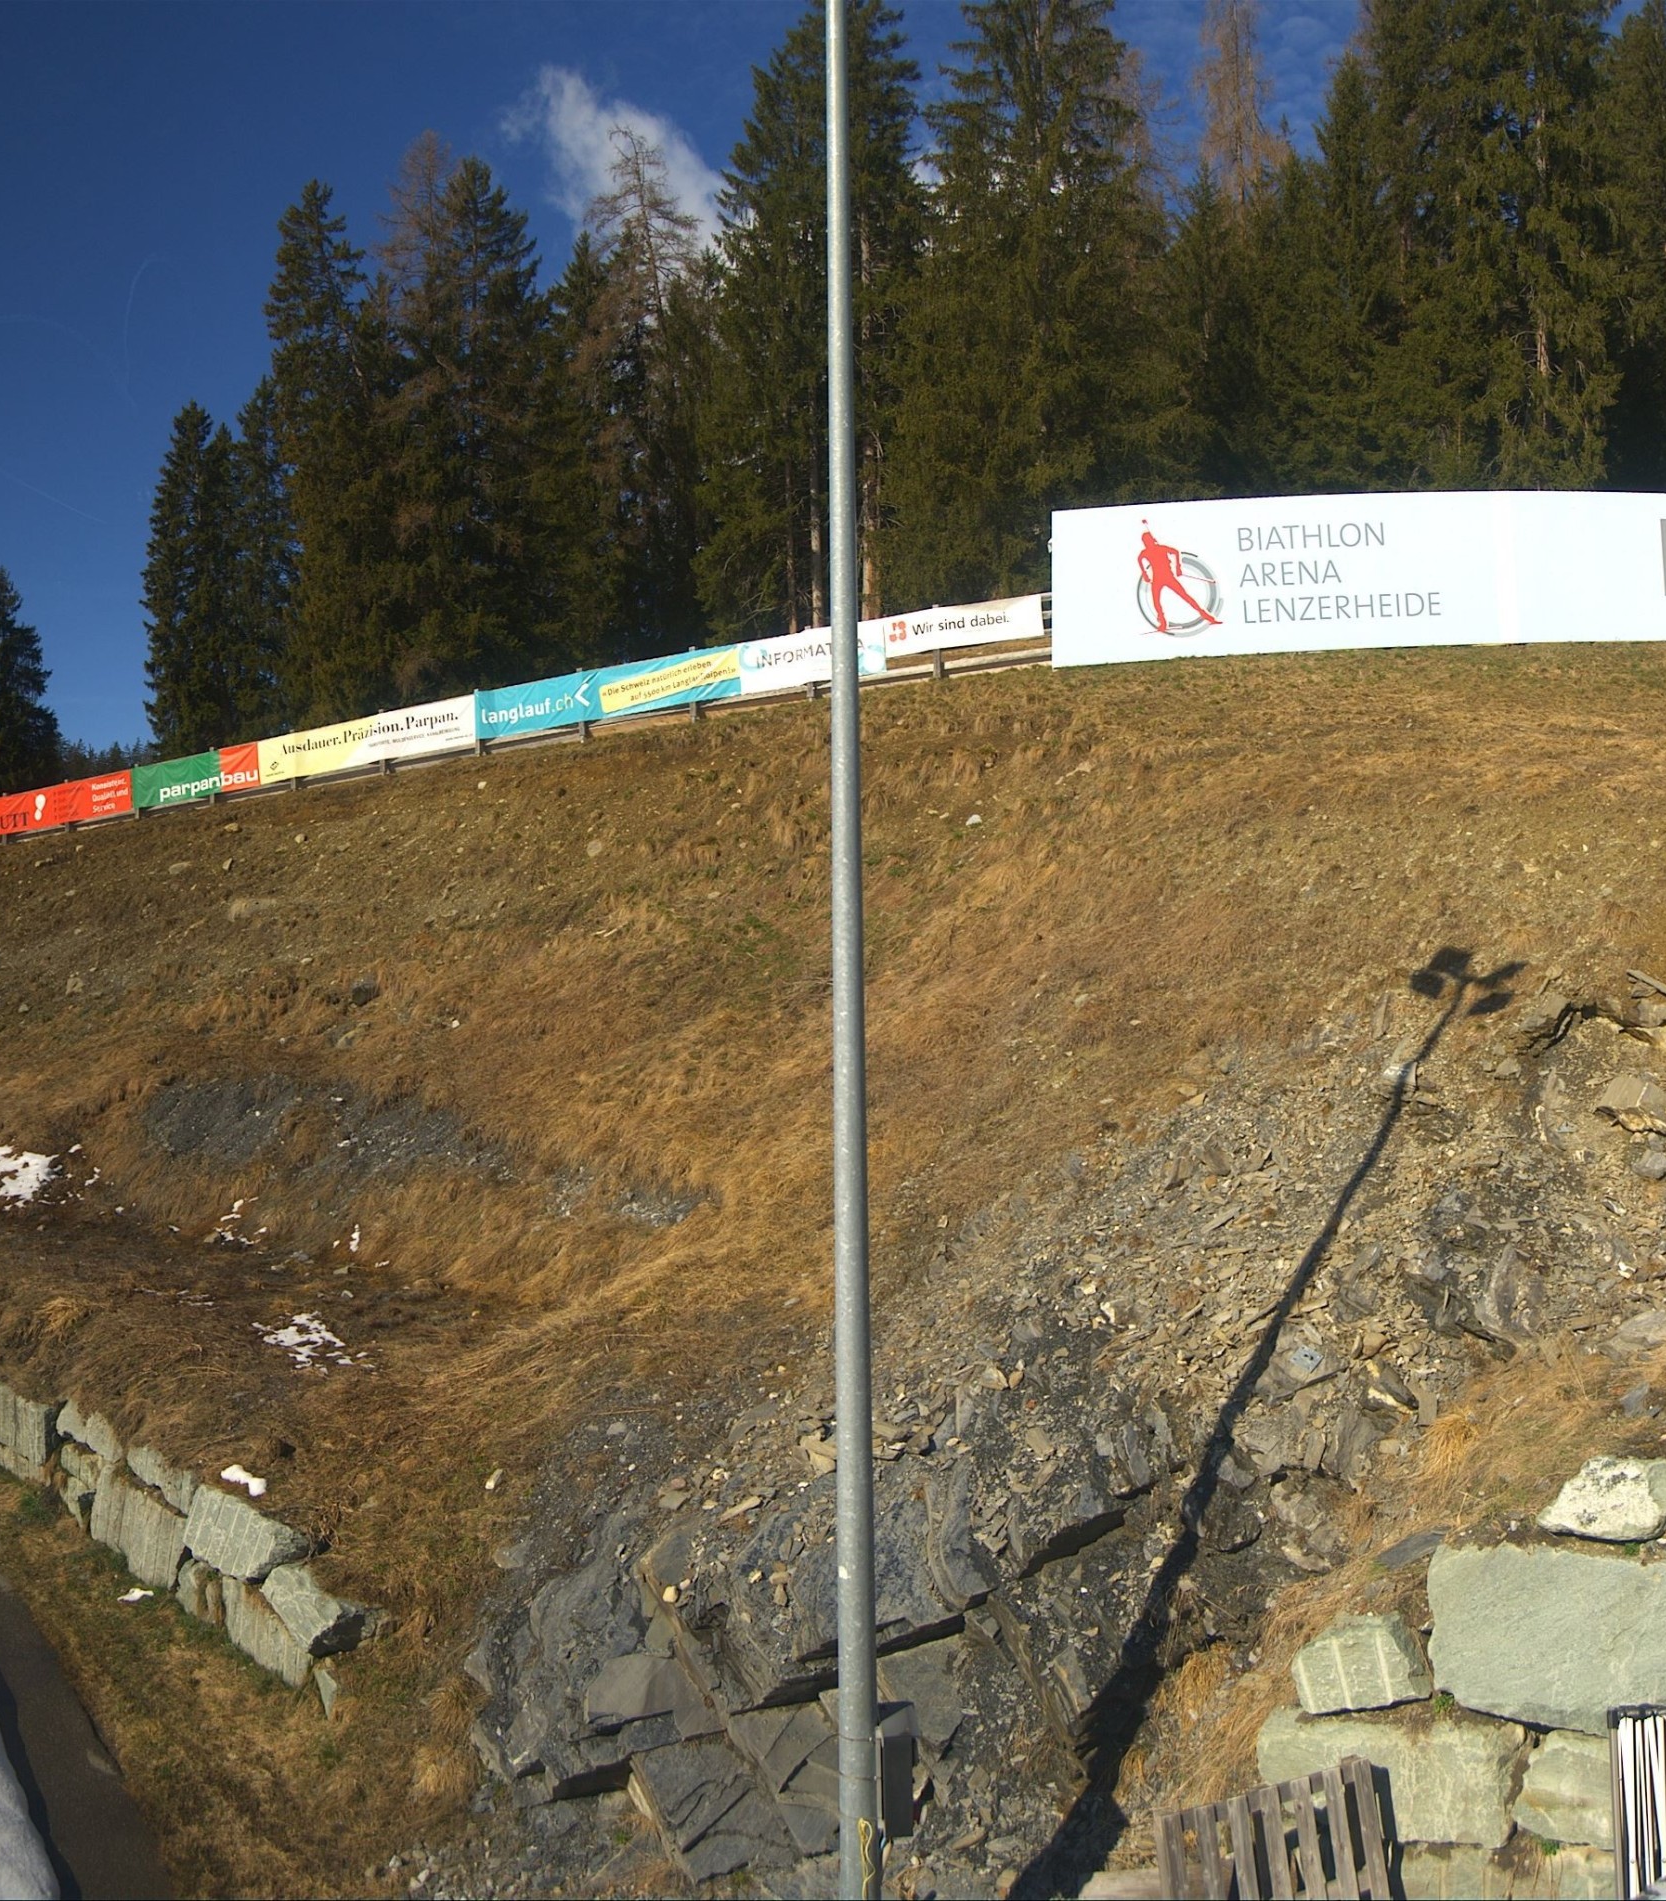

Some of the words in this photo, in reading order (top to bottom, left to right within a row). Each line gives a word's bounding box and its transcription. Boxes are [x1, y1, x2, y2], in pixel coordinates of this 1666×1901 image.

[1237, 521, 1386, 553] BIATHLON
[1239, 560, 1342, 589] ARENA
[912, 623, 934, 636] Wir
[938, 616, 965, 632] sind
[970, 611, 1010, 628] dabei.
[1241, 591, 1442, 625] LENZERHEIDE
[756, 638, 864, 669] INFORMATA
[621, 679, 650, 692] Schweiz
[652, 669, 682, 683] natürlich
[683, 661, 711, 673] erleben
[481, 693, 573, 725] langlauf.ch
[630, 692, 642, 701] auf
[159, 769, 259, 802] parpanbau
